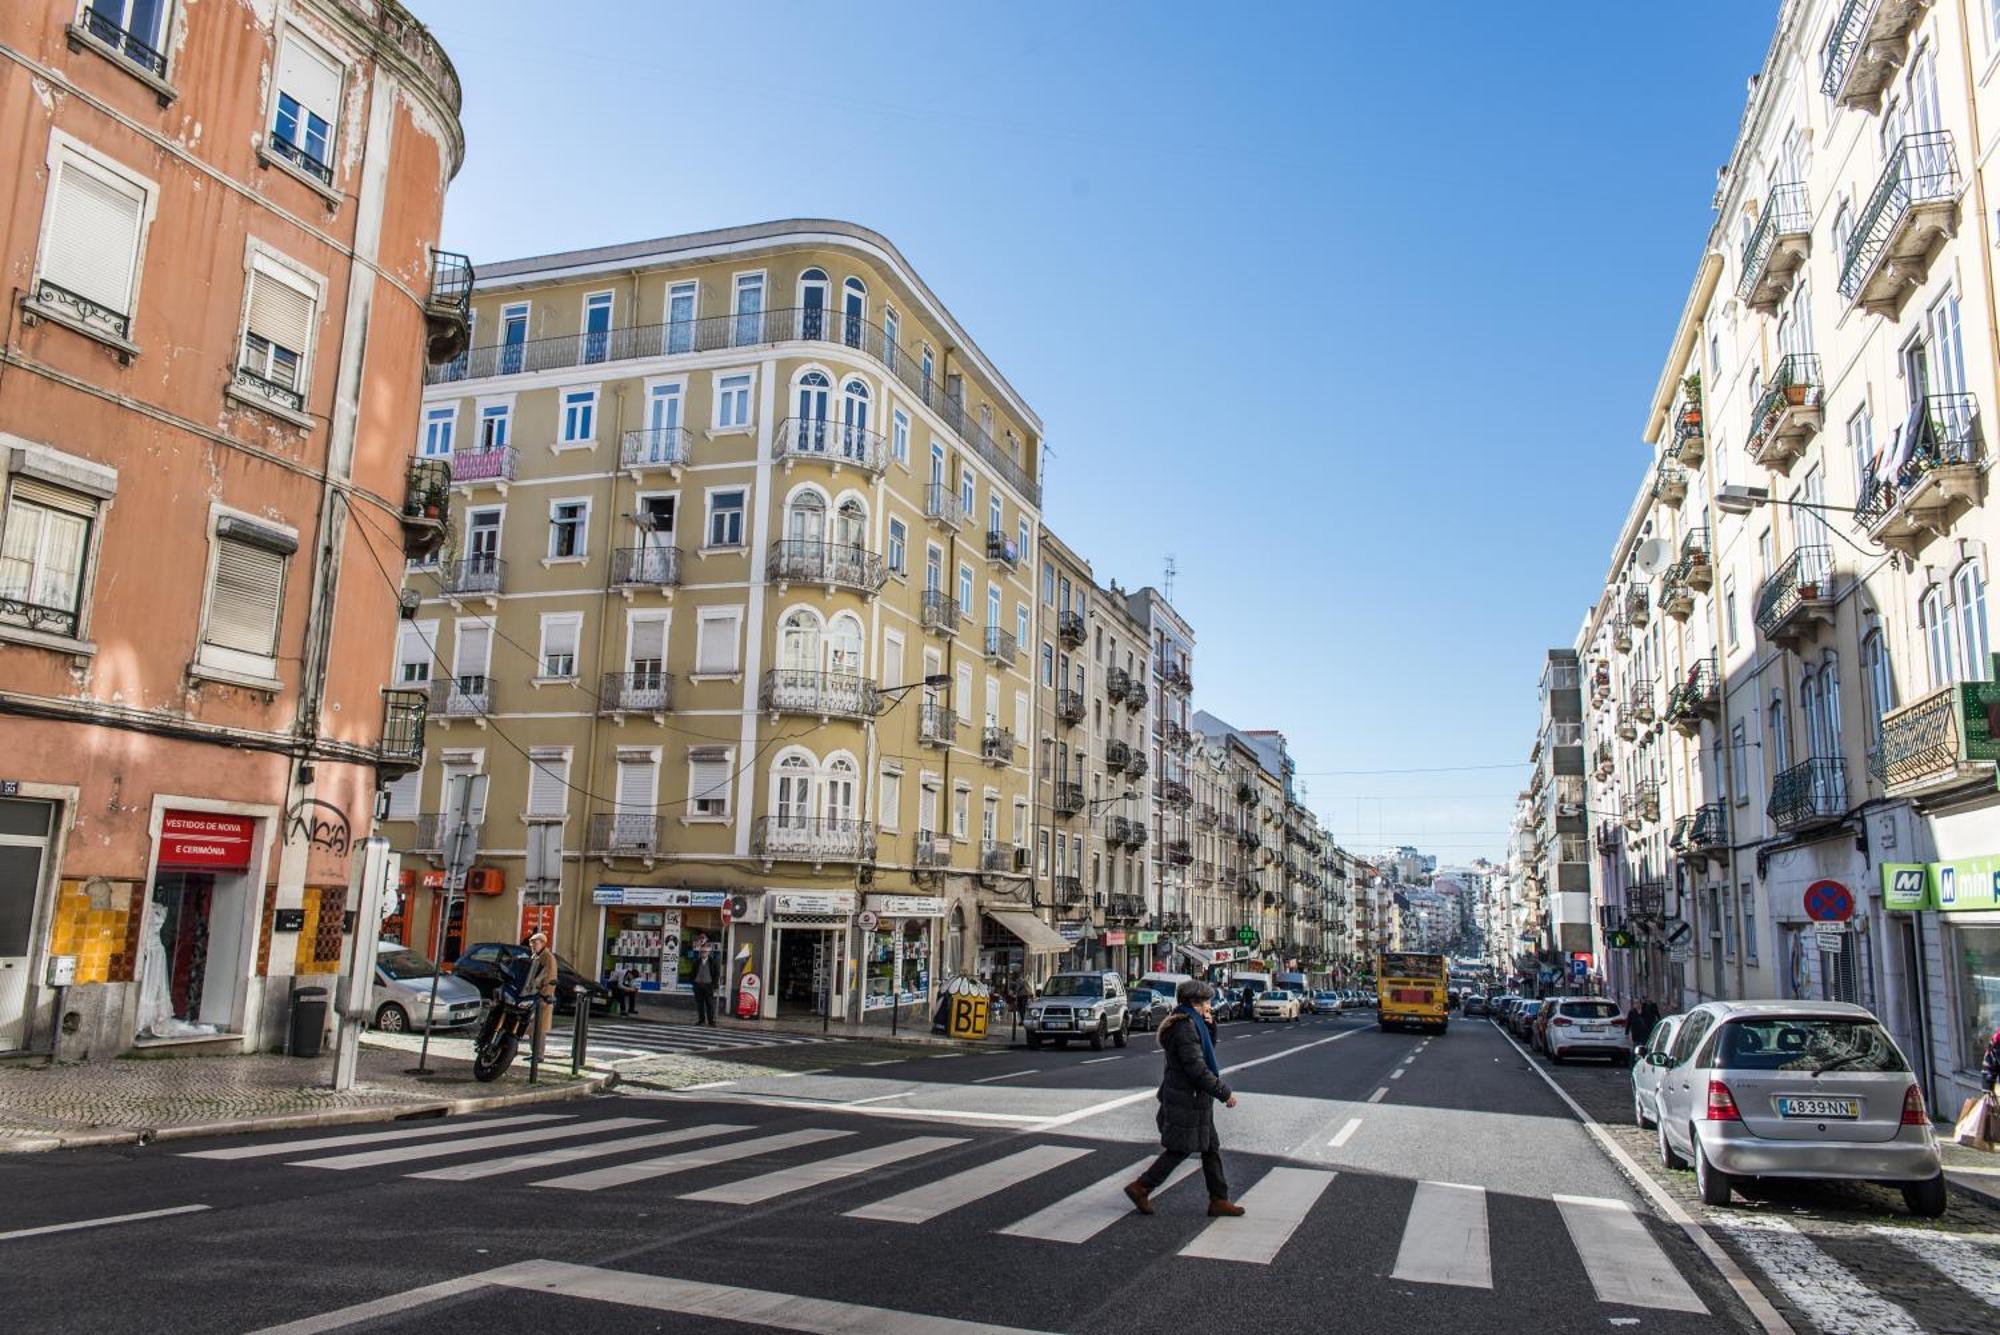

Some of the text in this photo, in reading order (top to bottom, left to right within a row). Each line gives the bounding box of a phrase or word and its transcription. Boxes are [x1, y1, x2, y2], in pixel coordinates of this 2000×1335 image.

[166, 819, 241, 832] VESTIDOS DE NOIVA
[175, 845, 225, 855] E CERIMÓNIA
[1575, 961, 1584, 974] P
